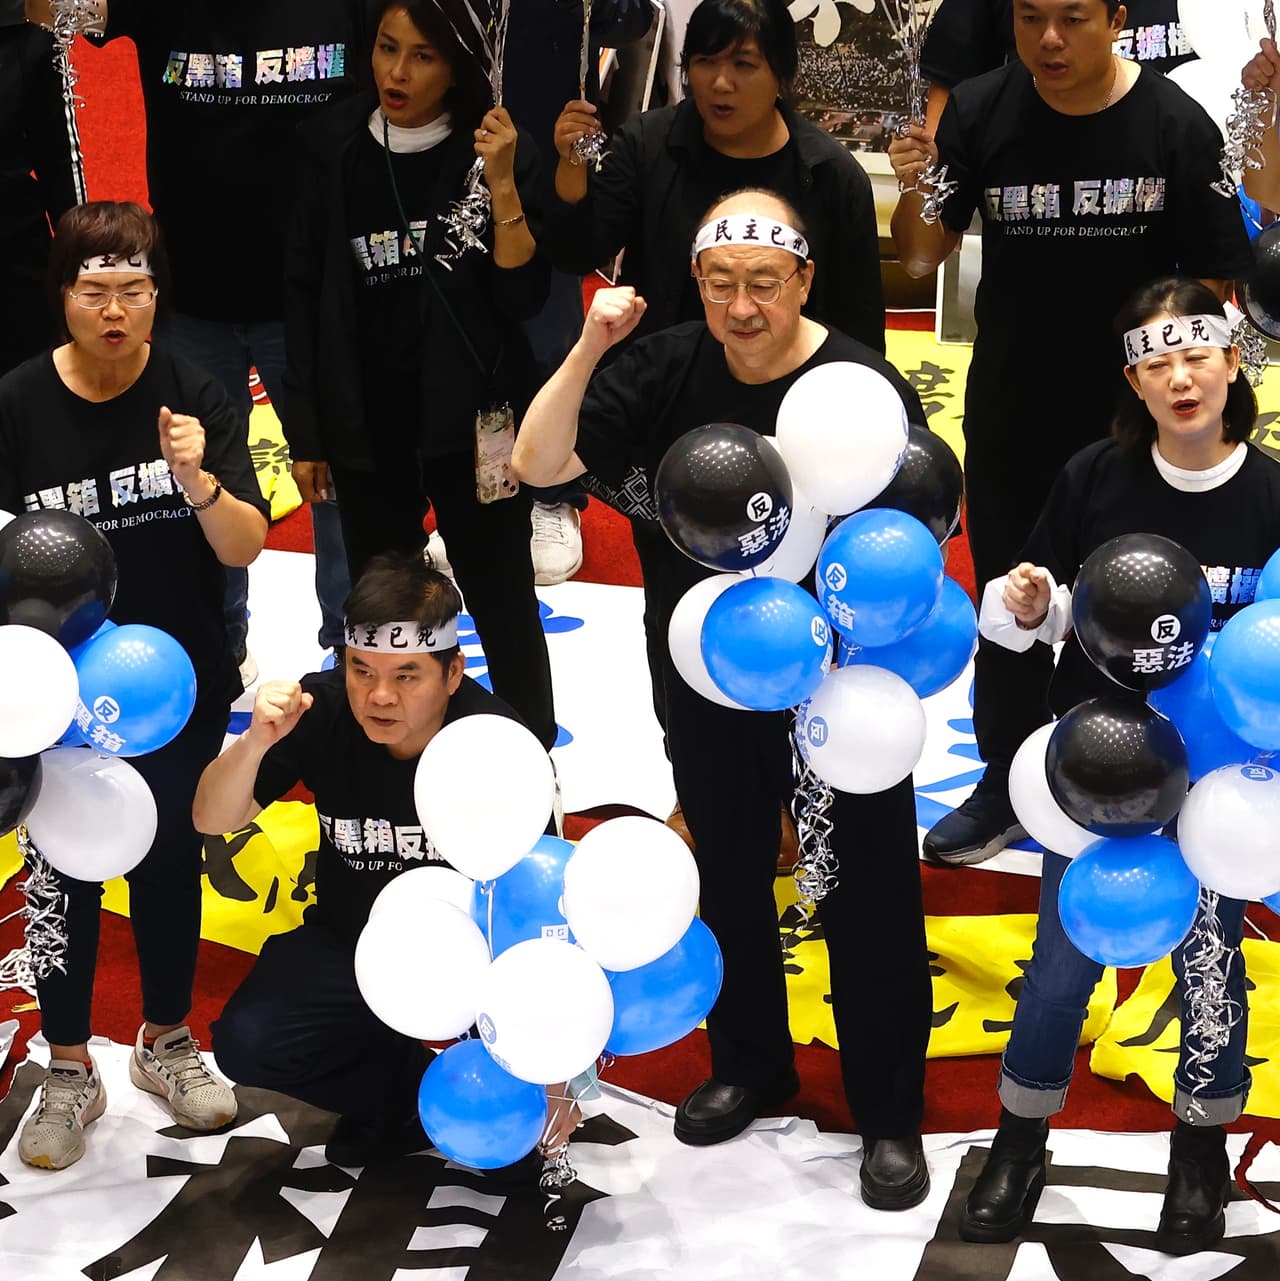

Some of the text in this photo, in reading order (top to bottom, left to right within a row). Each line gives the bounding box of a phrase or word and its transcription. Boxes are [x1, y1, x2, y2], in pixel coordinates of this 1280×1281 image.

[162, 42, 346, 89] 反黑箱 反擴權
[181, 90, 333, 105] STAND UP FOR DEMOCRACY
[1071, 177, 1167, 215] 反擴權
[1037, 224, 1051, 237] UP
[1053, 225, 1074, 237] FOR
[1126, 318, 1210, 360] 民主已死
[120, 506, 193, 528] DEMOCRACY
[736, 506, 792, 558] 惡法
[1131, 641, 1194, 674] 惡法
[368, 859, 385, 872] UP
